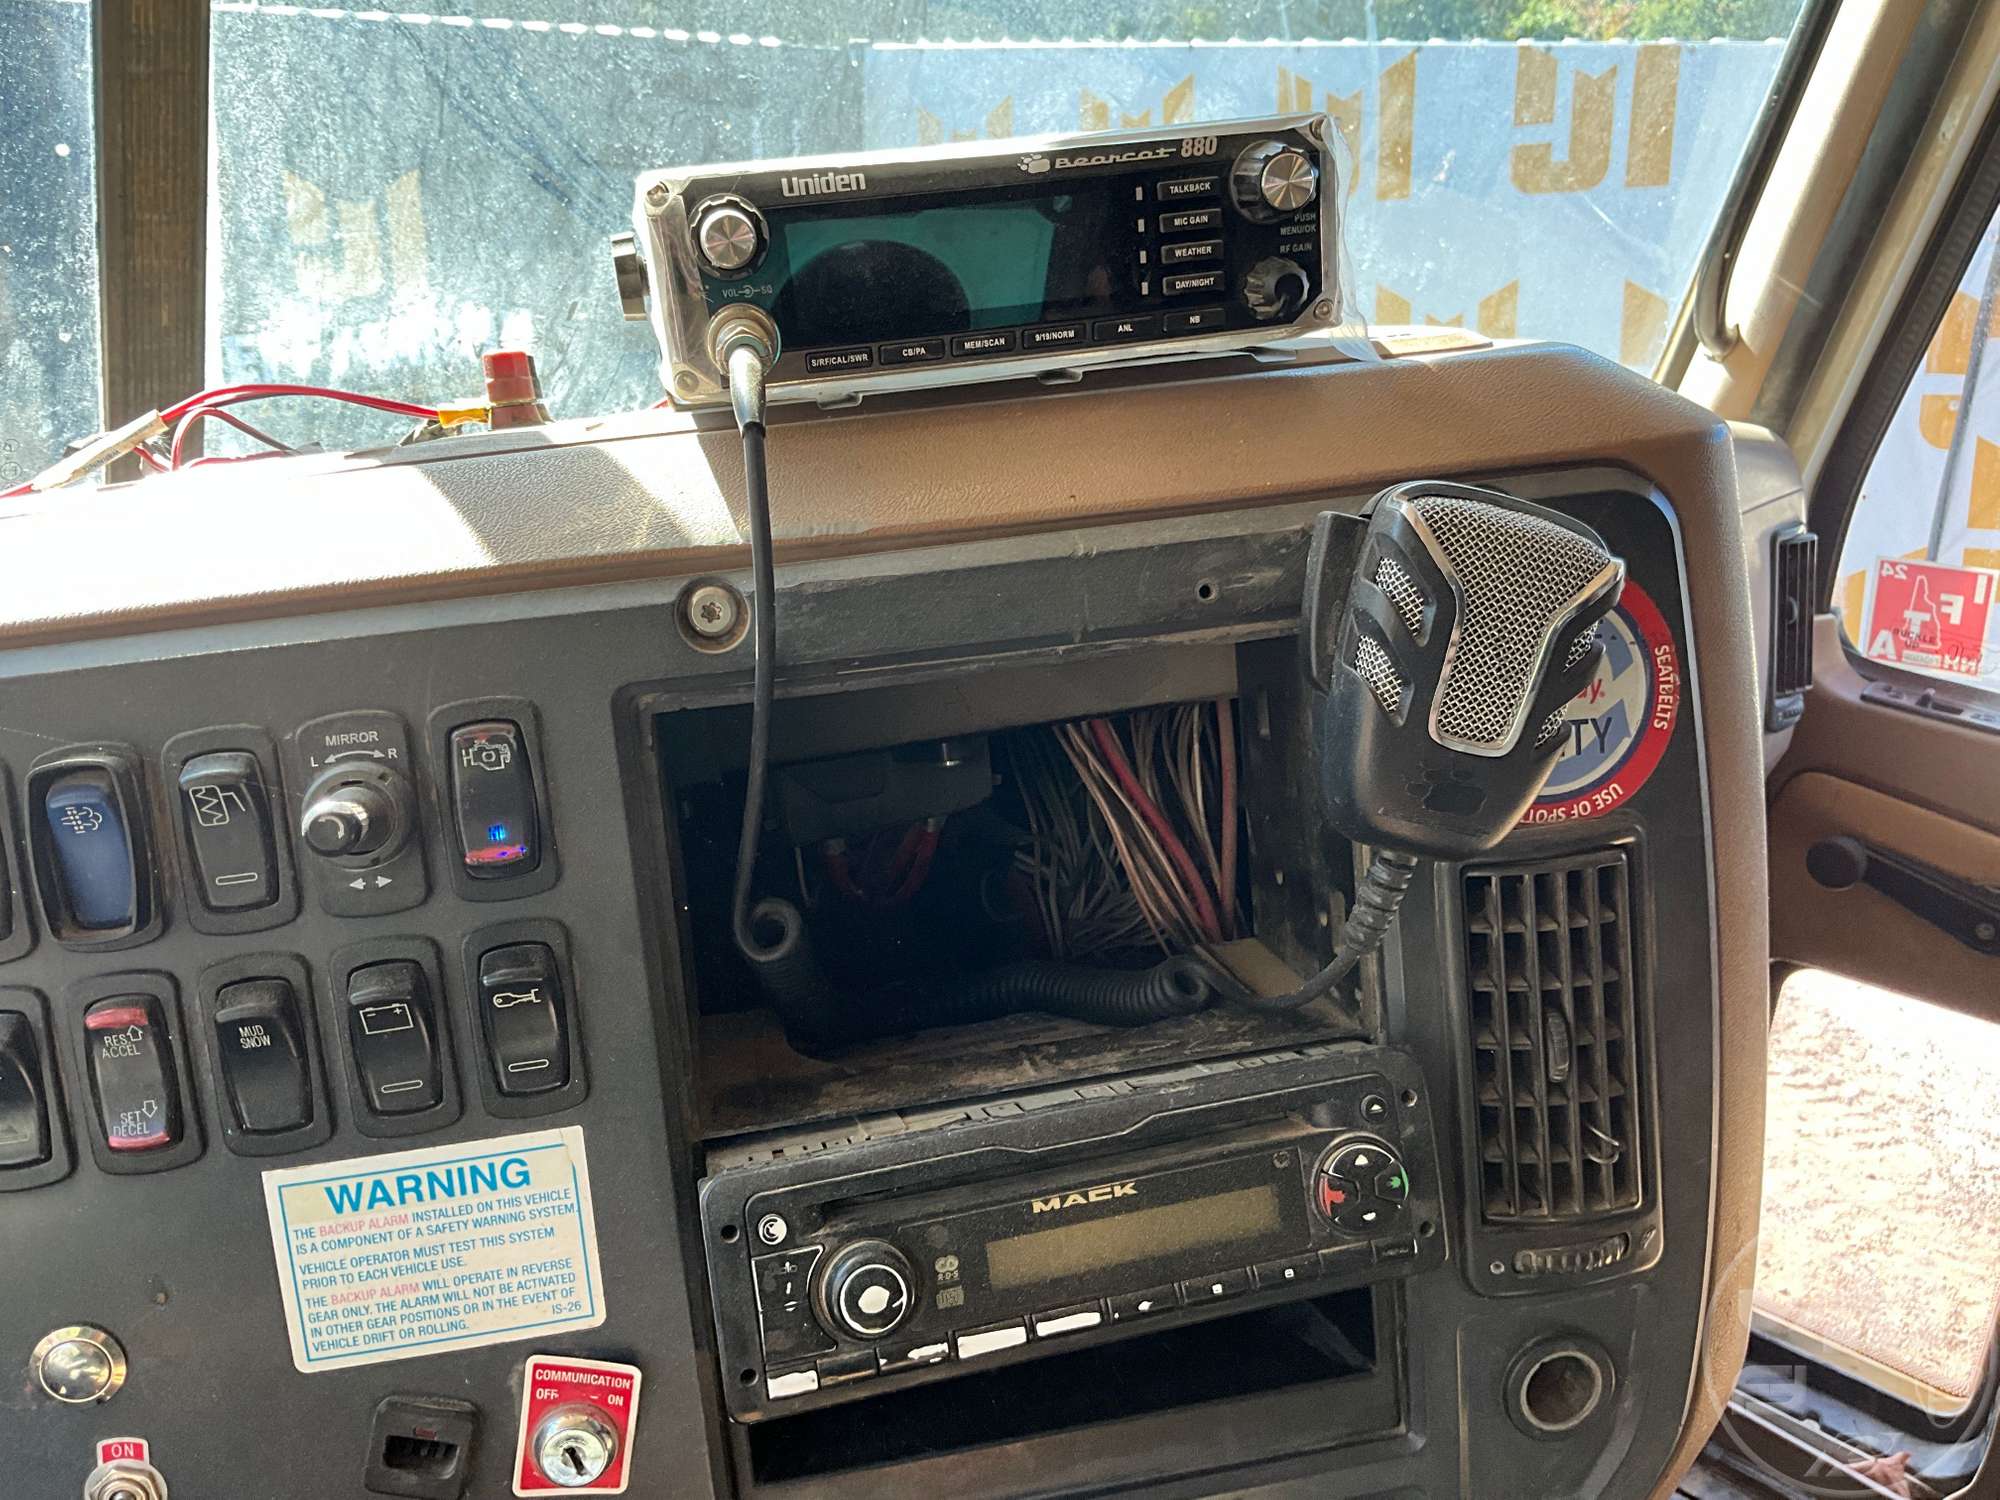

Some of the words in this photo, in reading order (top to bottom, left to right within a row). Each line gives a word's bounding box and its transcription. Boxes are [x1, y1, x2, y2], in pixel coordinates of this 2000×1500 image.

[1054, 147, 1177, 169] Bearcat
[1180, 136, 1218, 158] 880
[780, 172, 867, 197] Uniden
[1169, 181, 1212, 195] TALKBACK
[1174, 216, 1188, 226] MIC
[1189, 214, 1209, 225] GAIN
[1294, 212, 1317, 223] PUSH
[1279, 224, 1317, 236] MENU/OK
[1174, 246, 1212, 258] WEATHER
[1292, 242, 1313, 252] GAIN
[1175, 277, 1215, 290] DAY/NIGHT
[722, 288, 739, 298] VOL
[761, 284, 773, 294] SQ
[1189, 315, 1201, 325] NB
[1117, 323, 1133, 333] ANL
[964, 337, 1006, 350] MEM/SCAN
[902, 347, 926, 357] CB/PA
[811, 353, 868, 368] S/RF/CAL/SWR
[1654, 644, 1674, 730] SEATBELTS
[325, 731, 379, 747] MIRROR
[388, 748, 398, 760] R
[311, 756, 319, 768] L
[1592, 783, 1624, 810] USE
[1571, 801, 1591, 819] OF
[239, 1025, 264, 1037] MUD
[240, 1035, 271, 1048] SNOW
[102, 1046, 141, 1059] ACCEL
[120, 1110, 142, 1125] SET
[113, 1123, 150, 1137] DECEL
[325, 1158, 531, 1214] WARNING
[1032, 1183, 1138, 1213] MACK
[293, 1228, 316, 1240] THE
[319, 1220, 366, 1236] BACKUP
[368, 1214, 408, 1228] ALARM
[412, 1204, 474, 1222] INSTALLED
[477, 1201, 494, 1212] ON
[497, 1197, 522, 1209] THIS
[525, 1189, 571, 1205] VEHICLE
[296, 1244, 307, 1254] IS
[309, 1242, 319, 1252] A
[321, 1231, 393, 1250] COMPONENT
[397, 1228, 412, 1239] OF
[415, 1226, 424, 1236] A
[427, 1219, 469, 1235] SAFETY
[472, 1211, 526, 1228] WARNING
[299, 1259, 347, 1275] VEHICLE
[350, 1250, 410, 1267] OPERATOR
[413, 1244, 446, 1258] MUST
[449, 1239, 477, 1252] TEST
[480, 1235, 506, 1247] THIS
[509, 1228, 555, 1243] SYSTEM
[302, 1276, 337, 1289] PRIOR
[340, 1273, 354, 1283] TO
[358, 1268, 388, 1281] EACH
[391, 1261, 438, 1276] VEHICLE
[441, 1256, 467, 1268] USE.
[306, 1296, 328, 1308] THE
[331, 1289, 377, 1304] BACKUP
[380, 1282, 420, 1297] ALARM
[423, 1278, 449, 1290] WILL
[453, 1269, 503, 1285] OPERATE
[507, 1267, 518, 1277] IN
[522, 1259, 572, 1275] REVERSE
[308, 1310, 339, 1323] GEAR
[342, 1304, 372, 1318] ONLY.
[376, 1301, 397, 1312] THE
[400, 1294, 440, 1309] ALARM
[443, 1289, 469, 1302] WILL
[473, 1285, 495, 1297] NOT
[499, 1283, 514, 1293] BE
[516, 1273, 576, 1291] ACTIVATED
[311, 1327, 323, 1337] IN
[325, 1321, 364, 1335] OTHER
[367, 1316, 397, 1328] GEAR
[400, 1306, 460, 1323] POSITIONS
[463, 1303, 480, 1313] OR
[483, 1300, 494, 1310] IN
[497, 1297, 519, 1308] THE
[522, 1290, 557, 1304] EVENT
[561, 1288, 575, 1298] OF
[552, 1301, 582, 1314] IS-26
[313, 1336, 360, 1352] VEHICLE
[363, 1331, 395, 1344] DRIFT
[399, 1328, 415, 1338] OR
[418, 1319, 469, 1335] ROLLING.
[535, 1369, 630, 1389] COMMUNICATION
[536, 1388, 559, 1400] OFF
[608, 1394, 624, 1406] ON
[111, 1445, 135, 1458] ON
